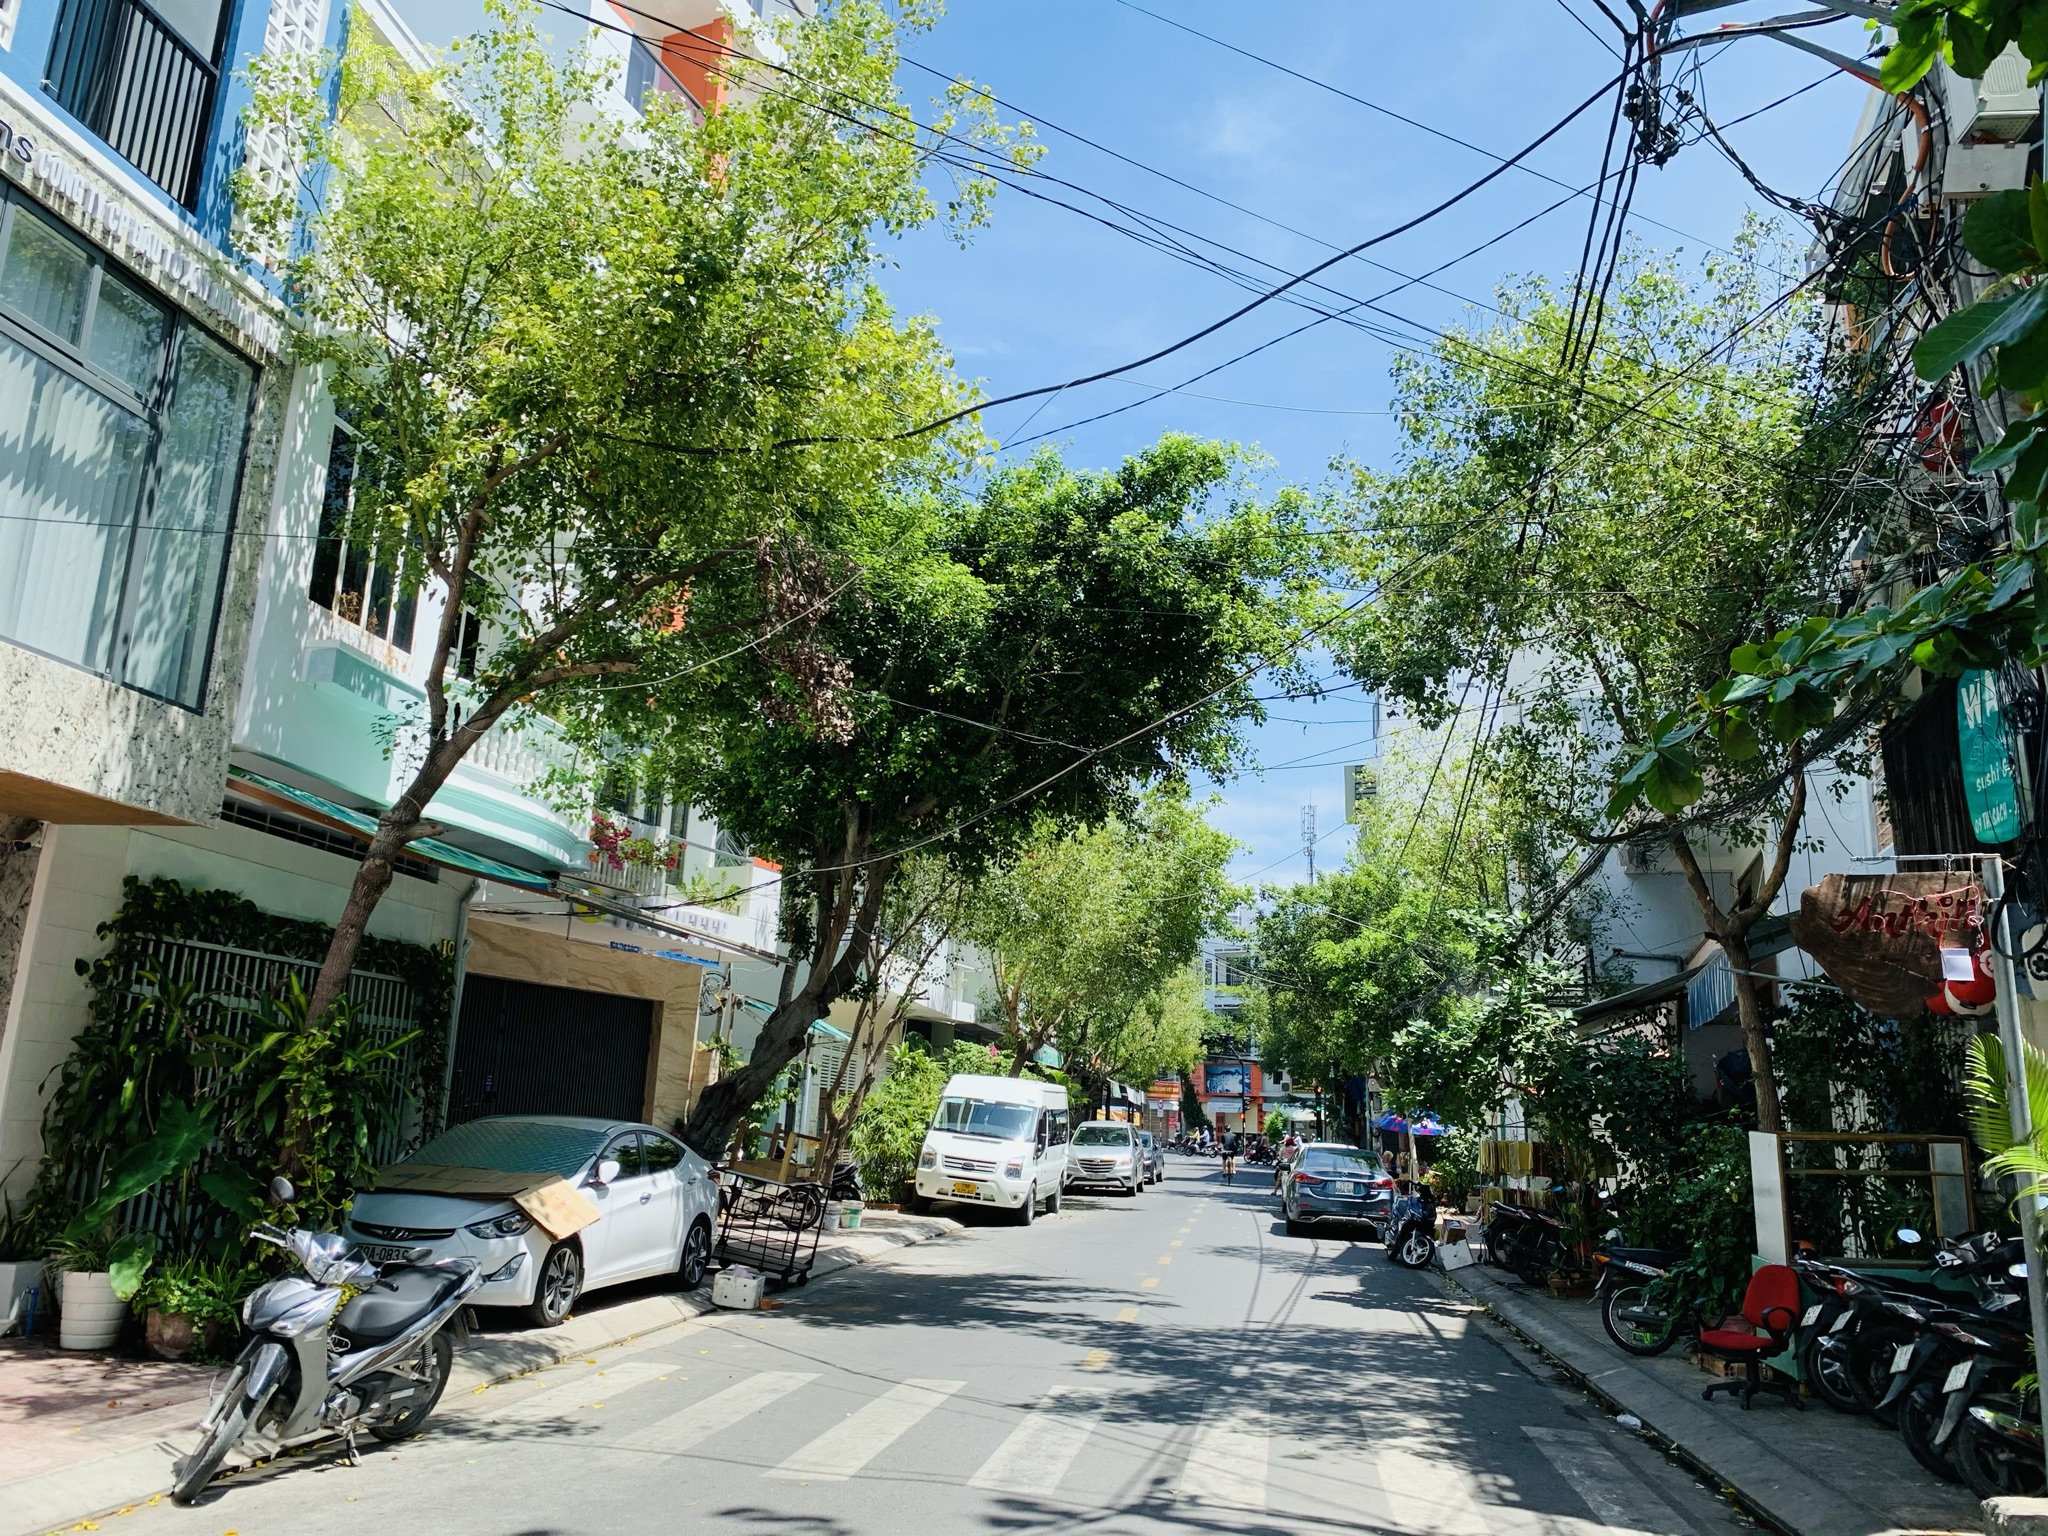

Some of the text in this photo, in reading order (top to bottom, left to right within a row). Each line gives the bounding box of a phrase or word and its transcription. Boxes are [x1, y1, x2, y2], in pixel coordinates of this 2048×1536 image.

[36, 148, 85, 204] CÔNG
[86, 184, 108, 222] TY
[106, 201, 131, 237] CP
[1976, 762, 2000, 792] sushi
[1830, 893, 1978, 938] Anthill
[442, 939, 455, 956] 10
